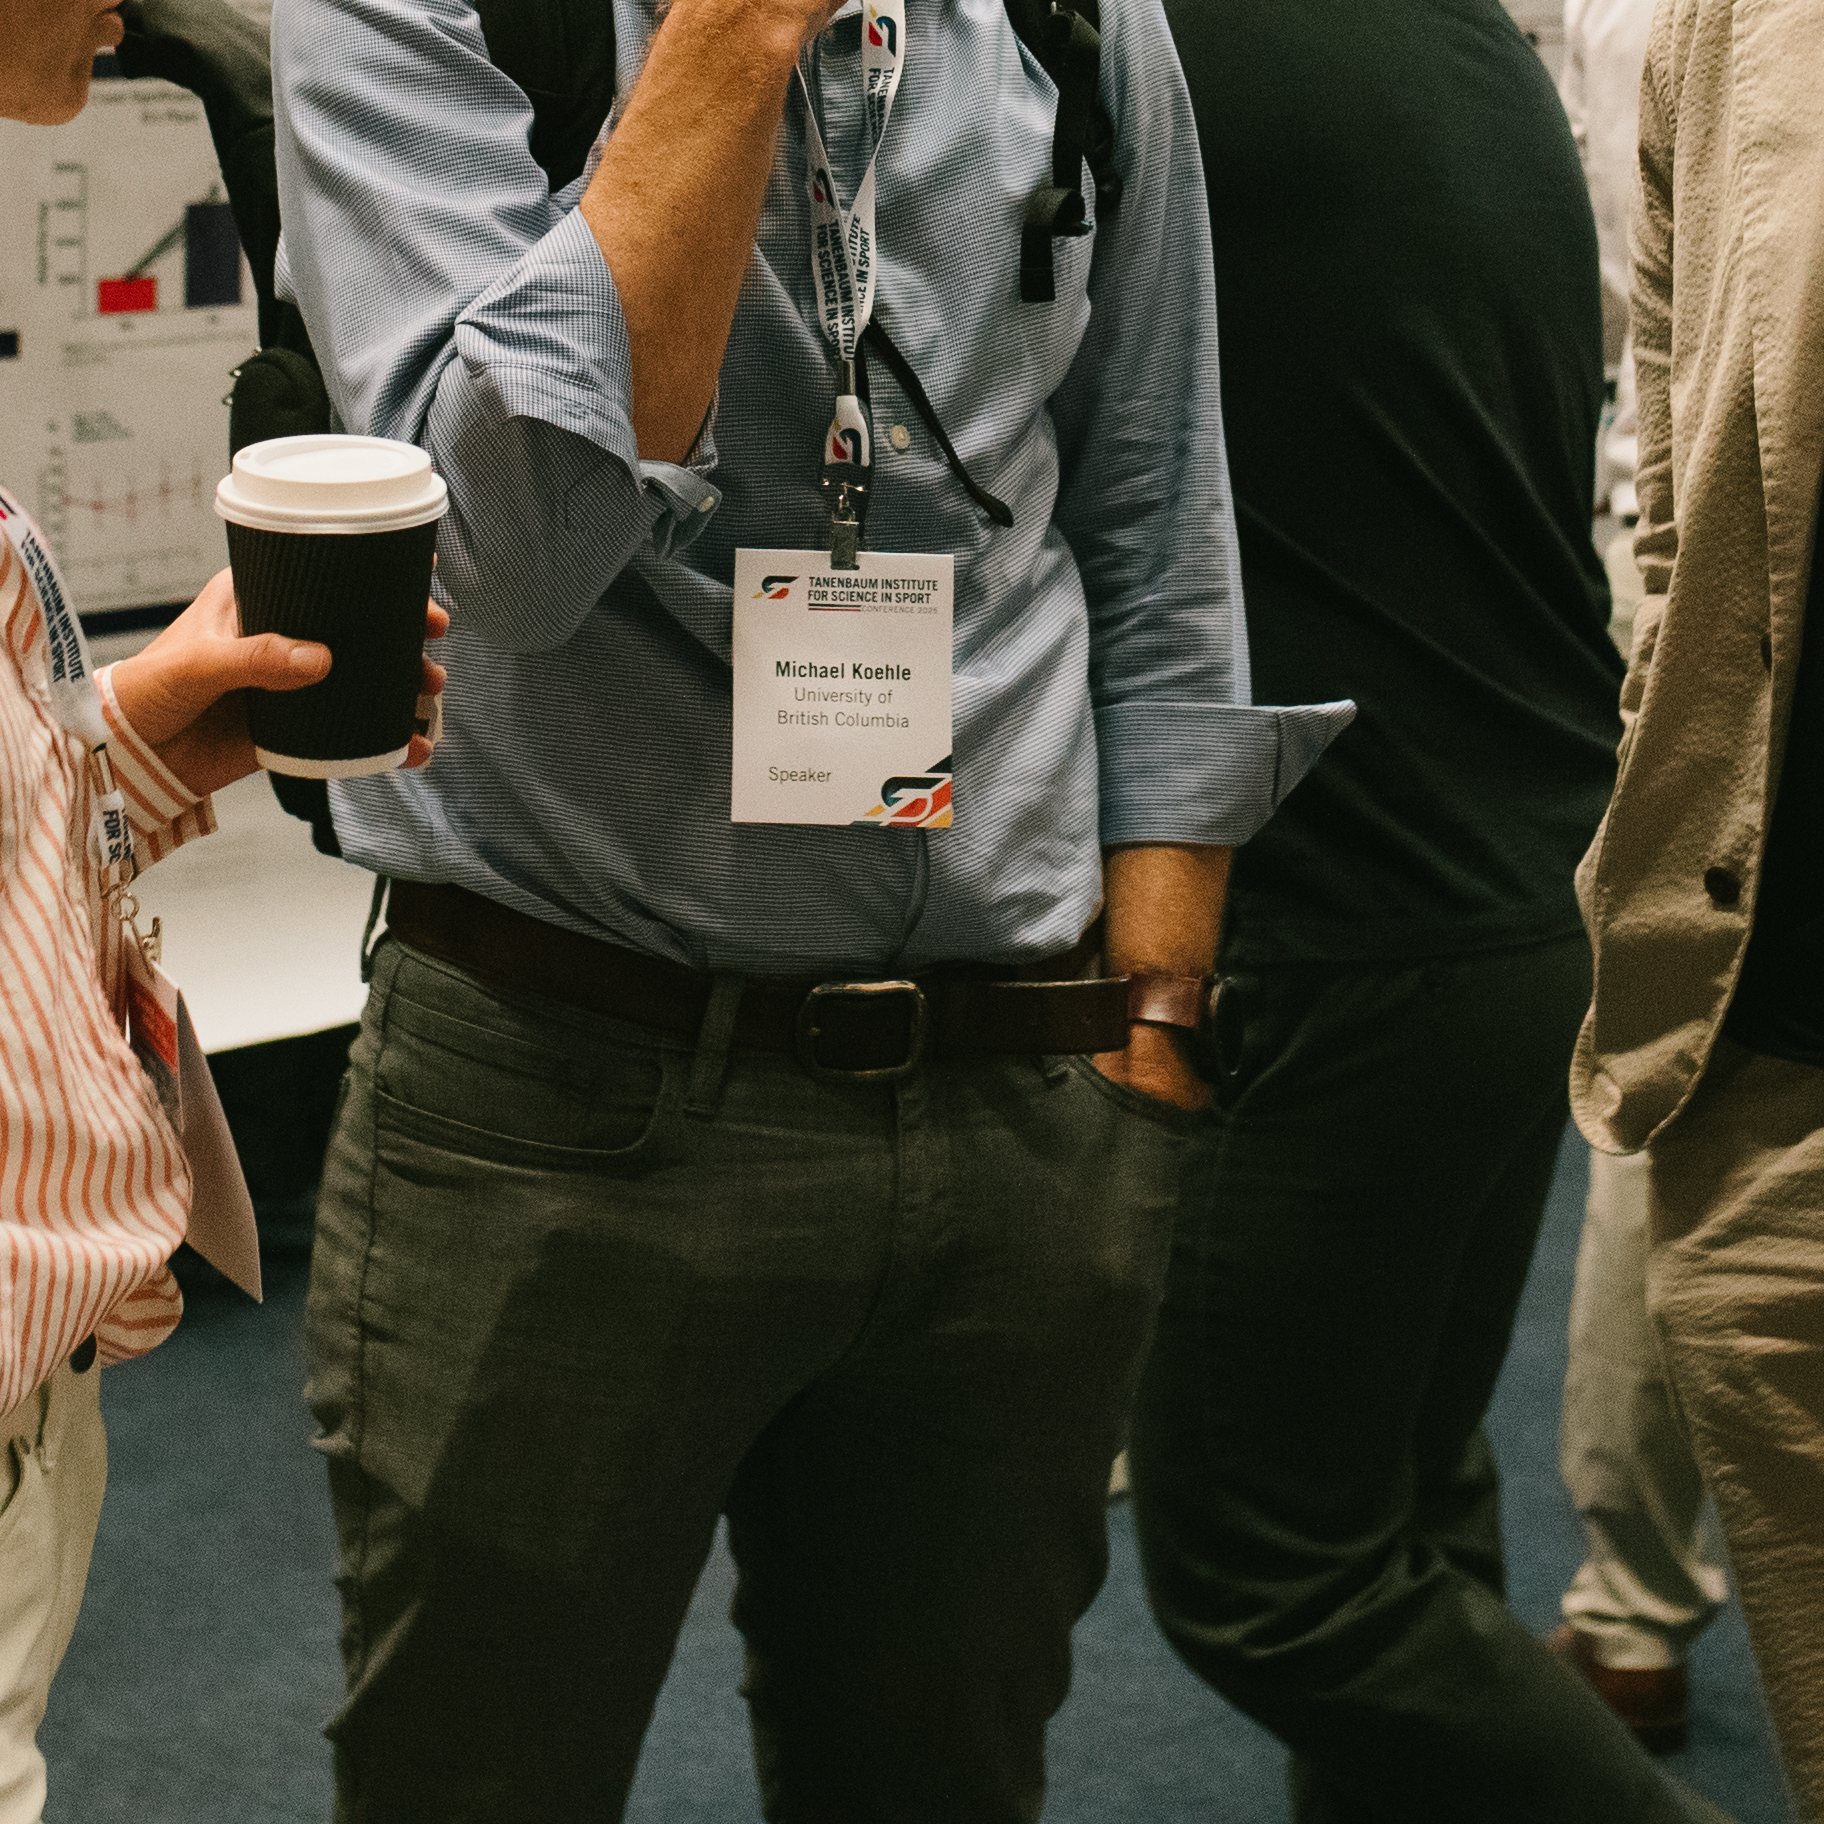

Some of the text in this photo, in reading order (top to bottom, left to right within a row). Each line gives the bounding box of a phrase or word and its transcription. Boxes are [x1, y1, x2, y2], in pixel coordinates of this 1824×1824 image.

[857, 227, 870, 269] SPORT
[828, 220, 854, 304] TANENBAUM
[818, 250, 838, 306] SCIENCE
[856, 268, 869, 284] IN
[826, 307, 839, 322] IN
[808, 576, 939, 592] TANENBAUM INSTITUTE
[808, 589, 932, 604] FOR SCIENCE IN SPORT
[861, 604, 915, 614] CONFERENCE
[48, 625, 60, 645] IN
[58, 612, 86, 684] INSTITUTE
[51, 641, 67, 684] SPORT
[775, 660, 912, 681] Michael Koehle
[793, 686, 894, 707] University of
[777, 709, 910, 729] British Columbia
[768, 765, 832, 785] Speaker
[102, 809, 122, 842] FOR
